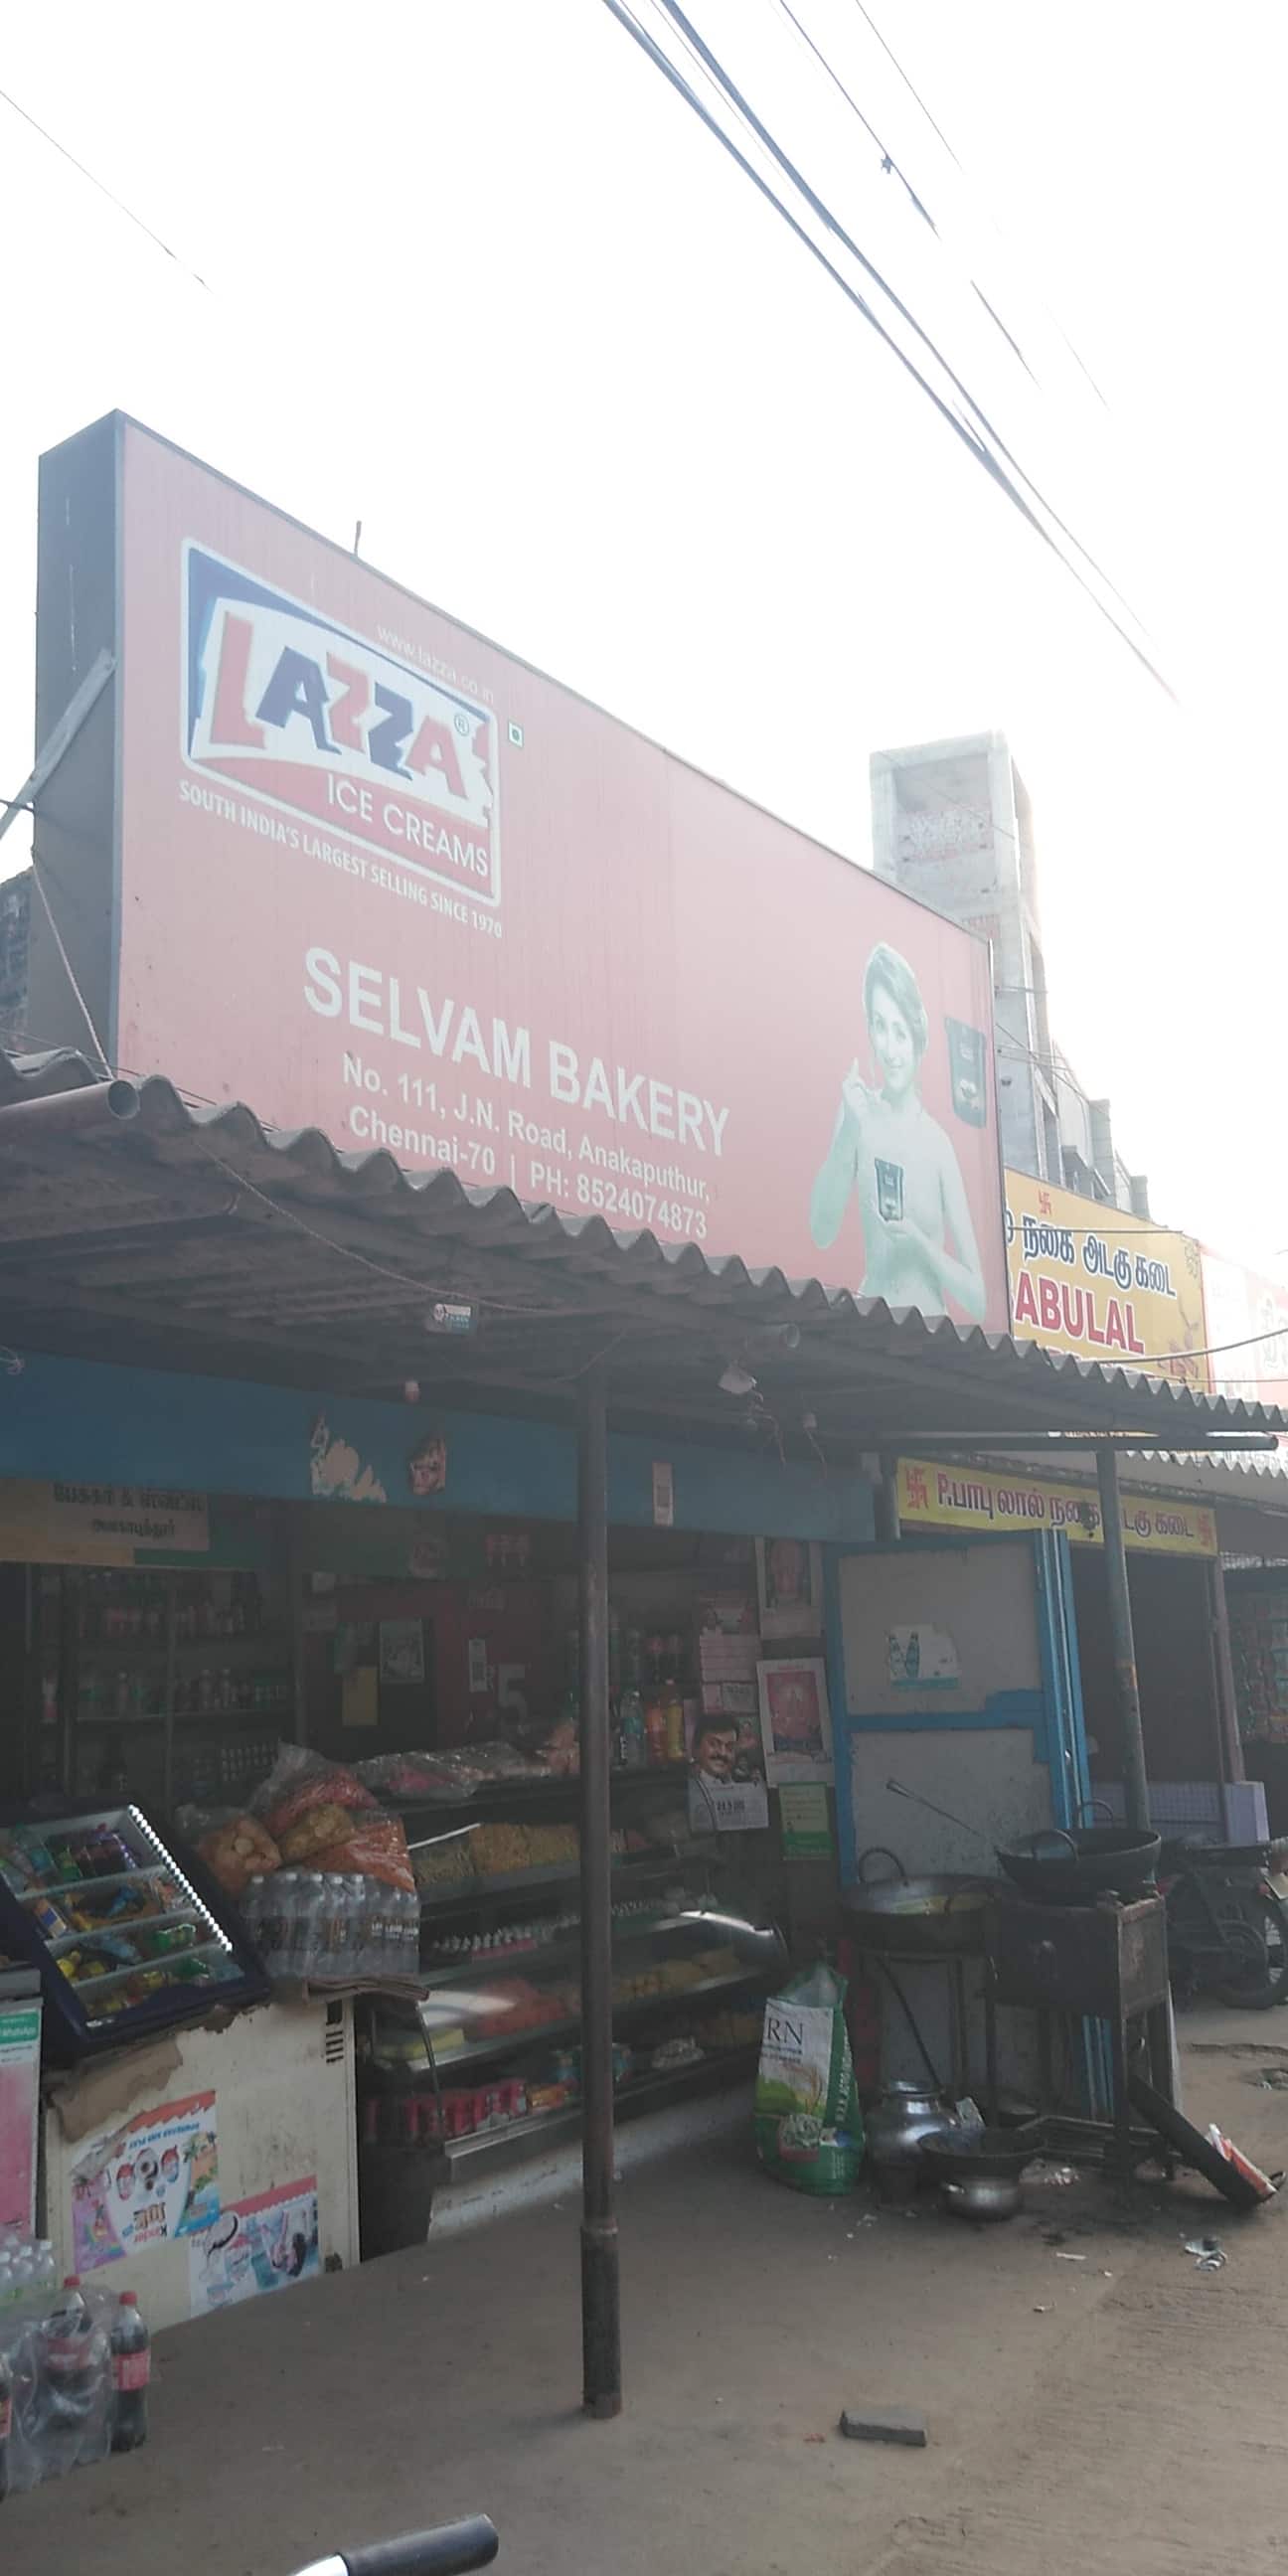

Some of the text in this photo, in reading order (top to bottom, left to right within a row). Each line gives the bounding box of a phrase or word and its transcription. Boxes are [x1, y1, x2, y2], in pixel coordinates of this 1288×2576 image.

[210, 611, 469, 800] LAZZA
[179, 779, 503, 939] SOUTH INDIA'S LARGEST SELLING SINCE 1970
[327, 773, 488, 877] ICE CREAMS
[303, 946, 730, 1157] SELVAM BAKERY
[343, 1051, 712, 1202] No. 111, J.N. Road, Anakaputhur,
[349, 1106, 495, 1176] Chennai-70
[531, 1161, 569, 1199] PH:
[576, 1174, 709, 1240] 8524074873
[1022, 1214, 1076, 1264] நகை
[1015, 1271, 1145, 1355] ABULAL
